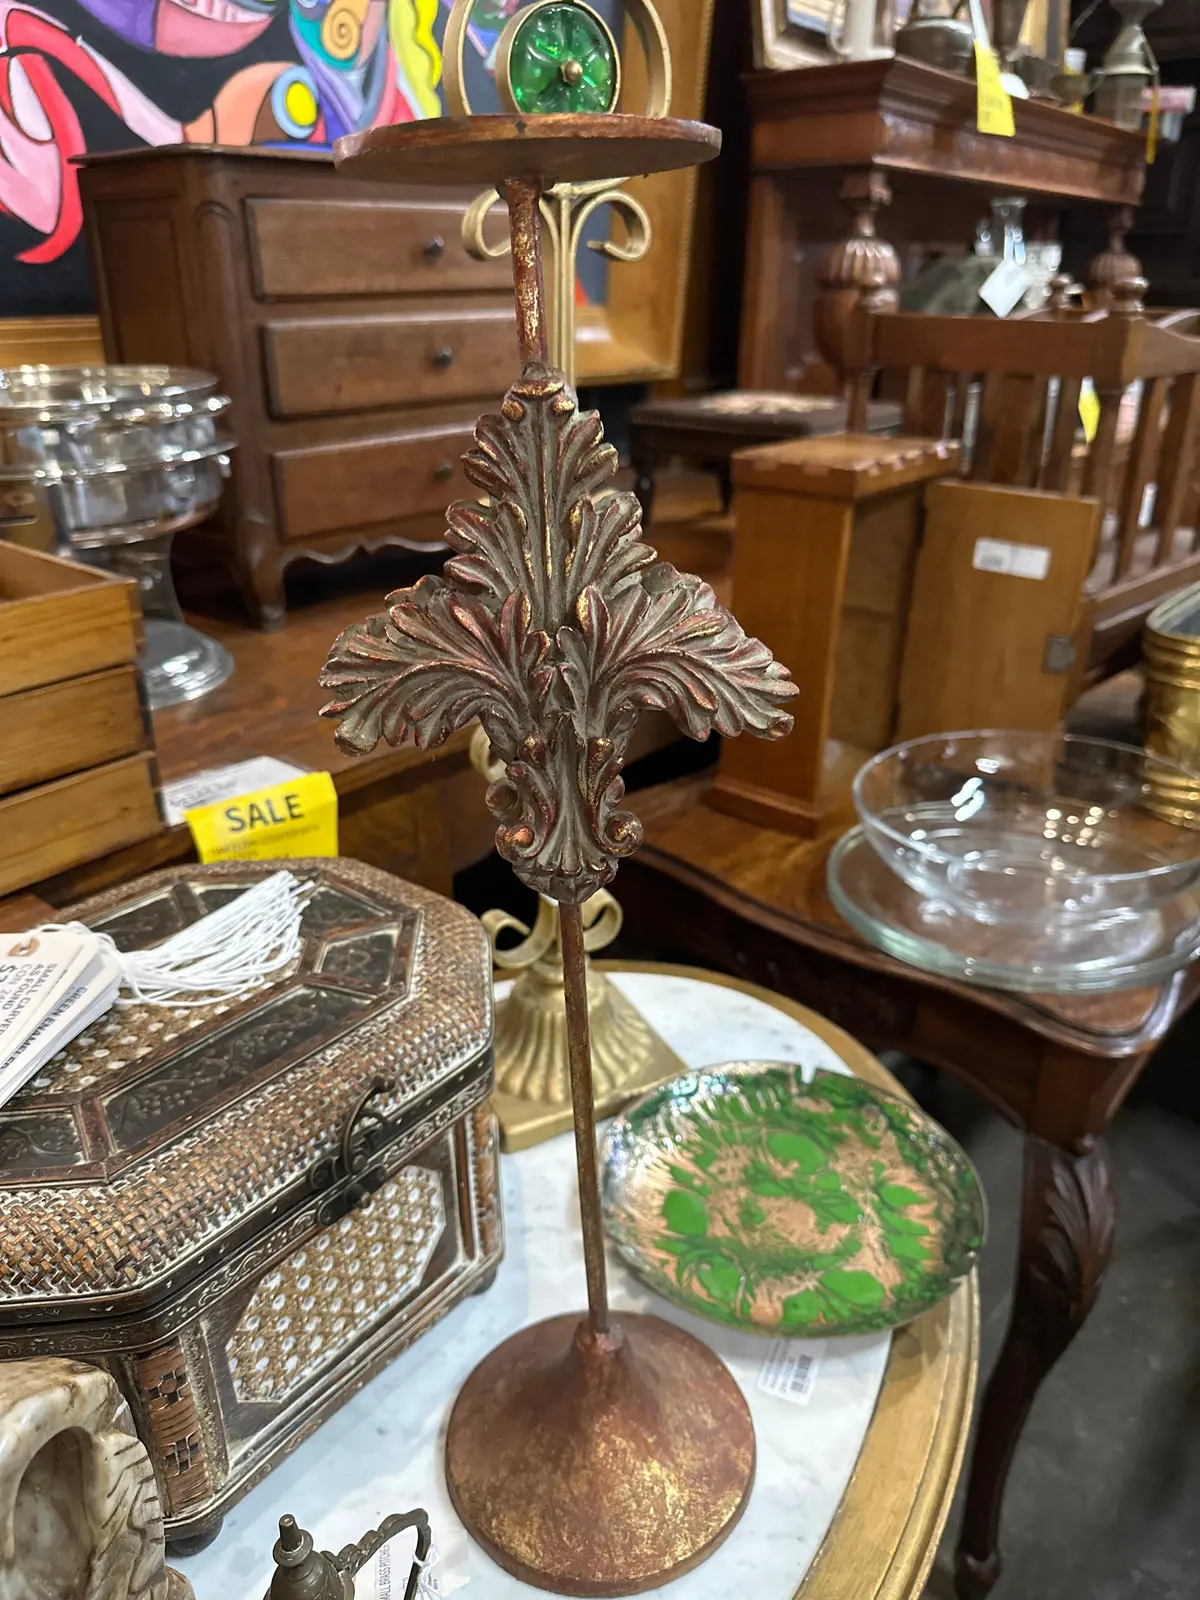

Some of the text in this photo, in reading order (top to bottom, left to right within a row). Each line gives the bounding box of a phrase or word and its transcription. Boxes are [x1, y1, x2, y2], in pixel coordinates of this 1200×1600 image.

[225, 793, 305, 832] SALE
[2, 963, 45, 1010] AS FOUND
[26, 963, 58, 995] SMALL
[52, 986, 88, 1016] GREEN
[379, 1567, 391, 1586] BRASS
[379, 1586, 391, 1600] MALL
